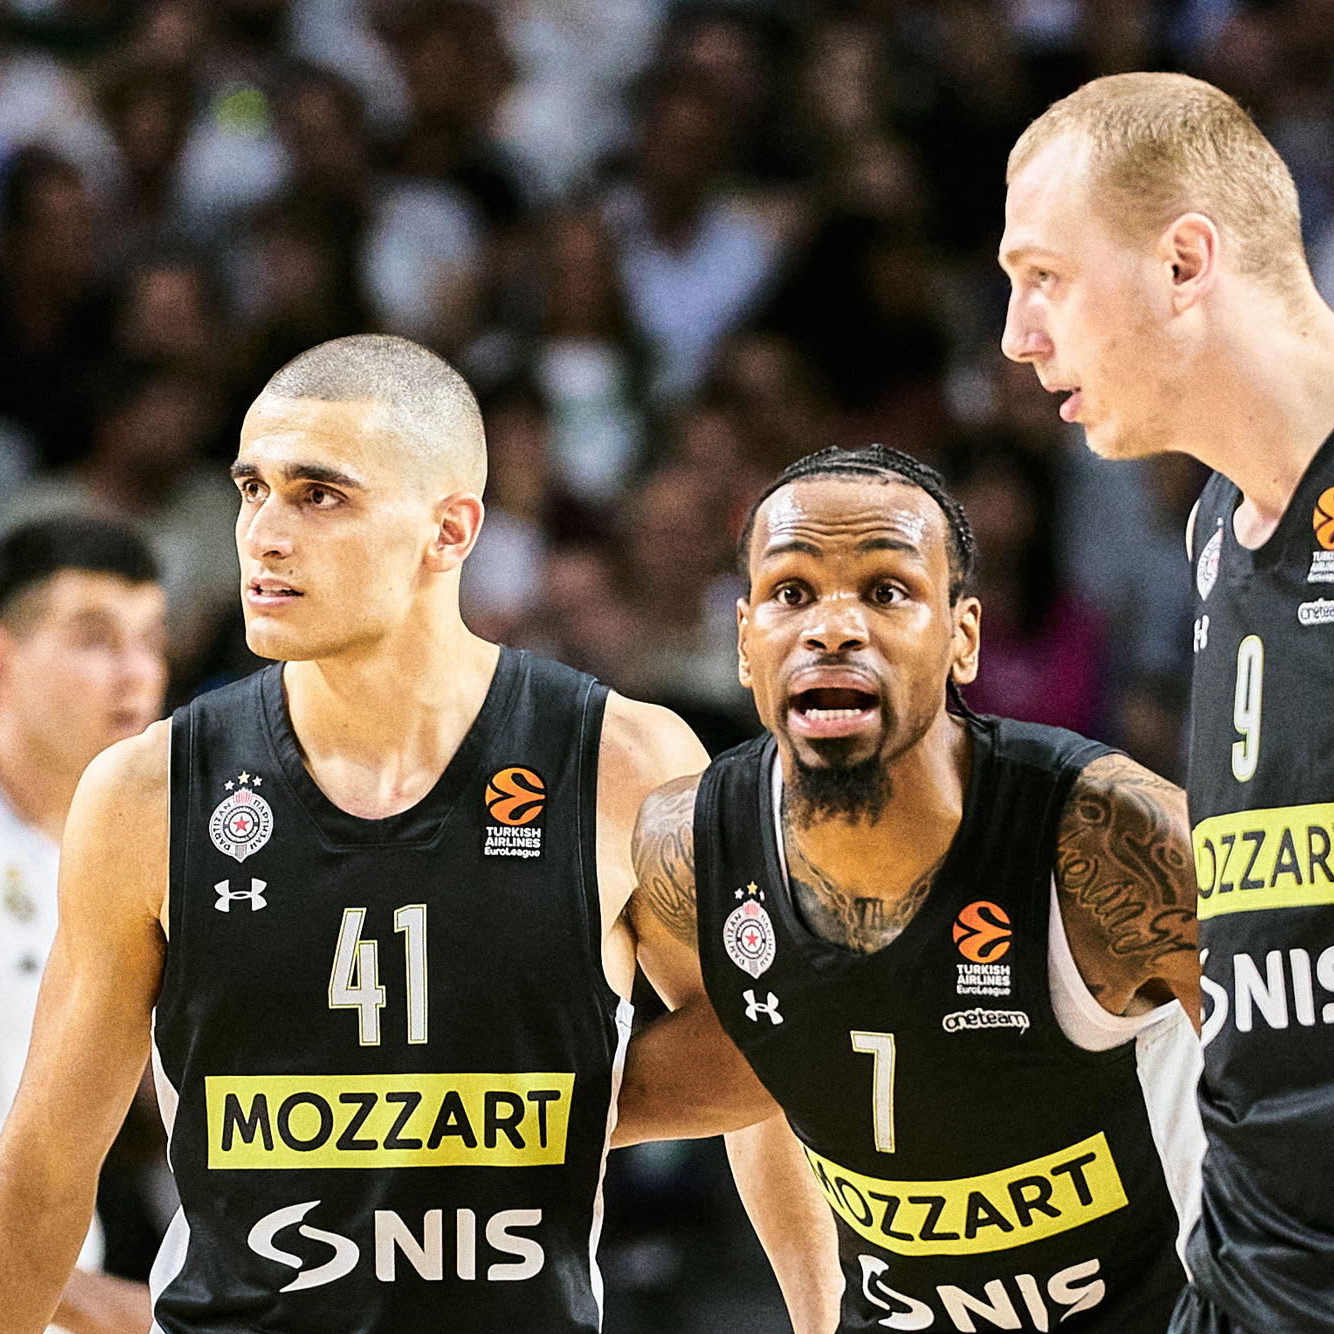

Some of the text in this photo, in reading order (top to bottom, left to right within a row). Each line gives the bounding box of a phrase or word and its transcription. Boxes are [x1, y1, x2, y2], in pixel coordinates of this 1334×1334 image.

[1232, 634, 1265, 783] 9
[484, 847, 541, 859] EuroLeague
[485, 837, 541, 848] AIRLINES
[486, 826, 542, 838] TURKISH
[328, 903, 428, 1046] 41
[956, 964, 1010, 976] TURKISH
[957, 975, 1010, 986] AIRLINES
[221, 1091, 561, 1152] MOZZART
[850, 1030, 896, 1154] 7
[375, 1208, 545, 1282] NIS
[936, 1258, 1106, 1333] NIS
